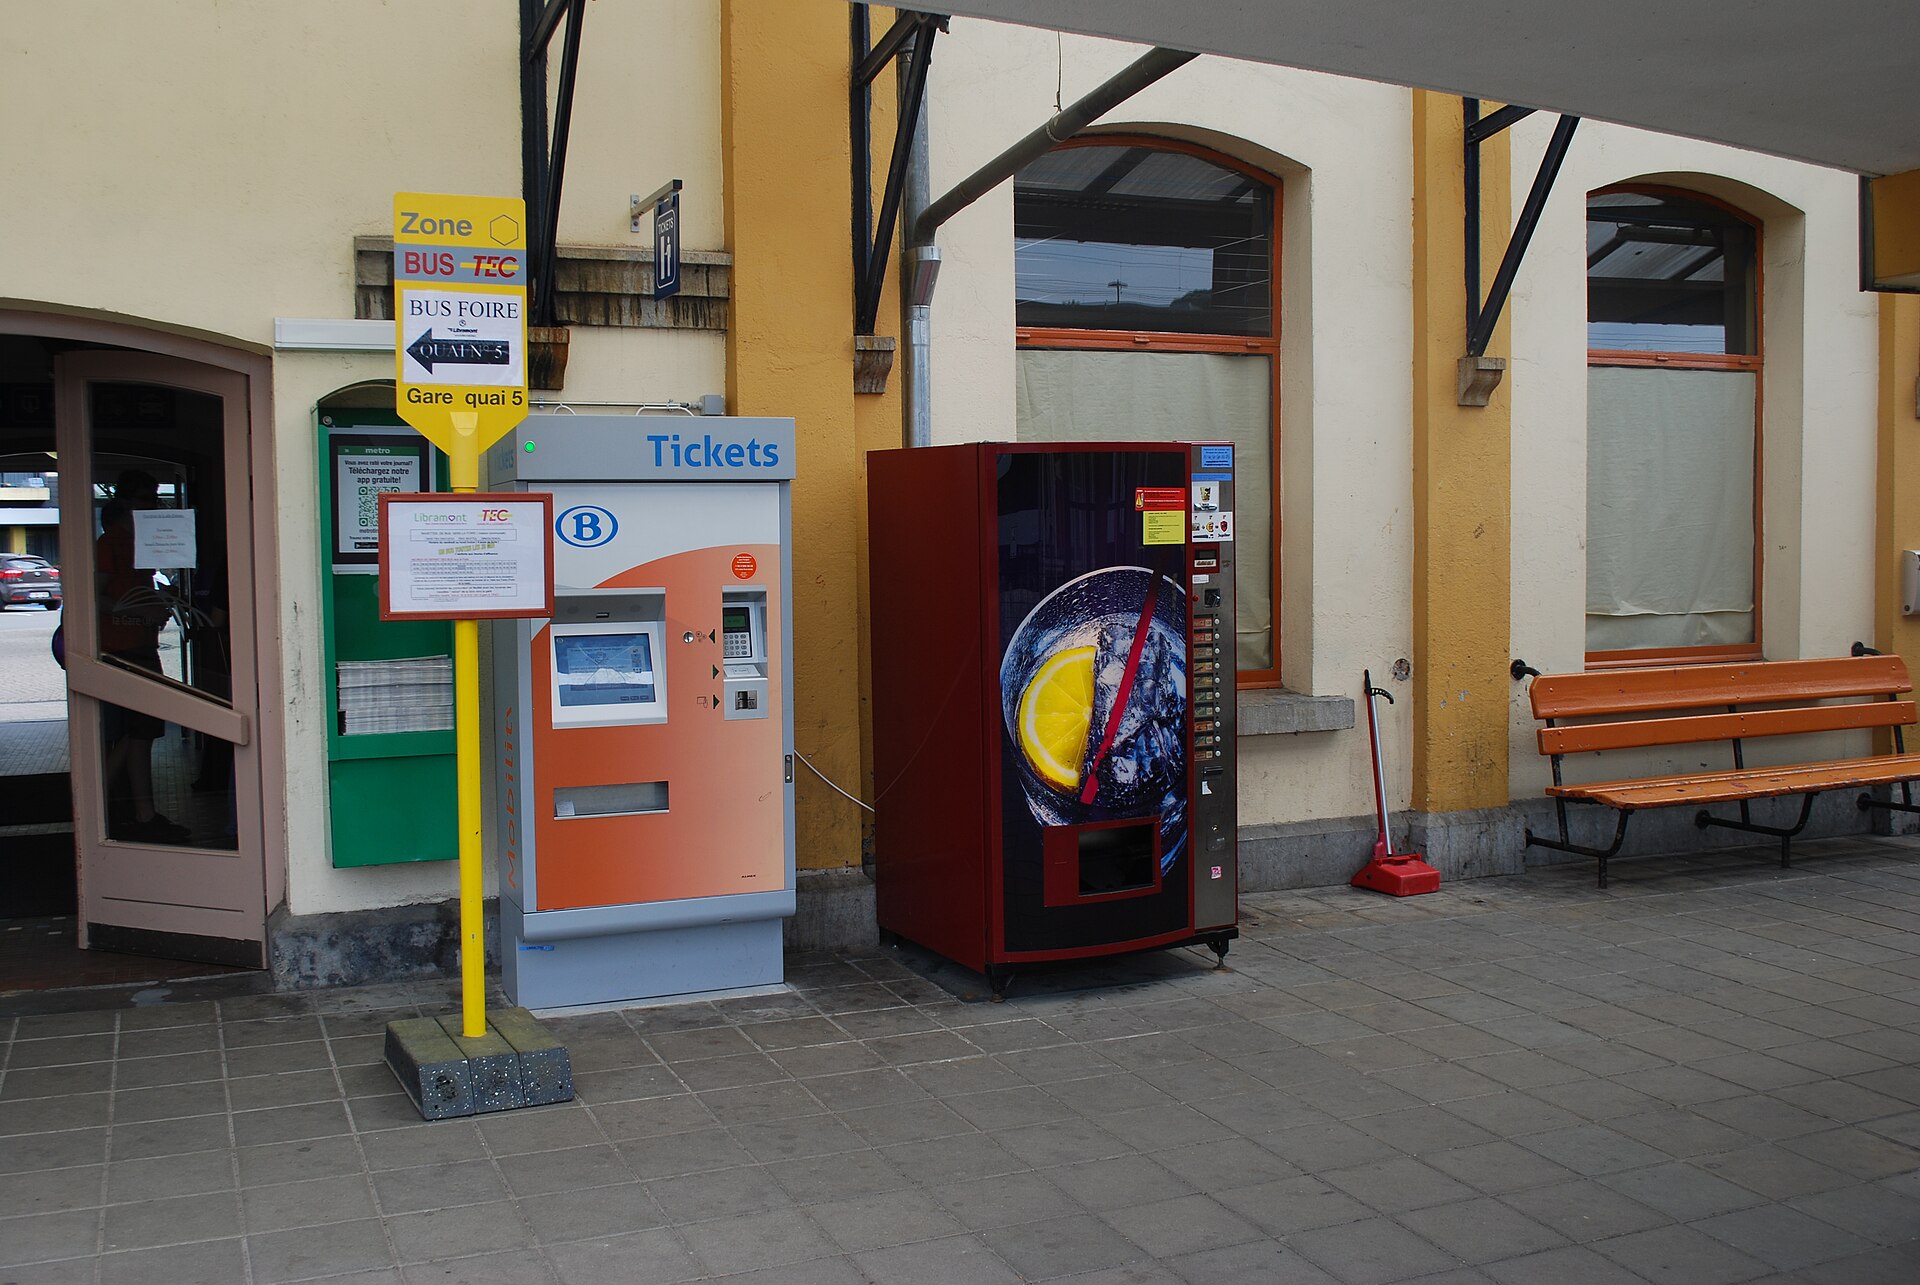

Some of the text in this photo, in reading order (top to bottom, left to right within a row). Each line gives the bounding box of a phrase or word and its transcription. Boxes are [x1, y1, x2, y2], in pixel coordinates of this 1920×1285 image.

[401, 212, 473, 237] Zone
[657, 217, 674, 235] TICKETS
[405, 252, 517, 278] BUS TEC
[410, 300, 519, 319] BUS FOIRE
[494, 346, 503, 359] 5
[407, 388, 523, 408] Gare quai 5
[647, 434, 779, 468] Tickets
[348, 467, 390, 476] Téléchargez
[372, 476, 401, 485] gratuite!
[482, 509, 509, 522] TEC
